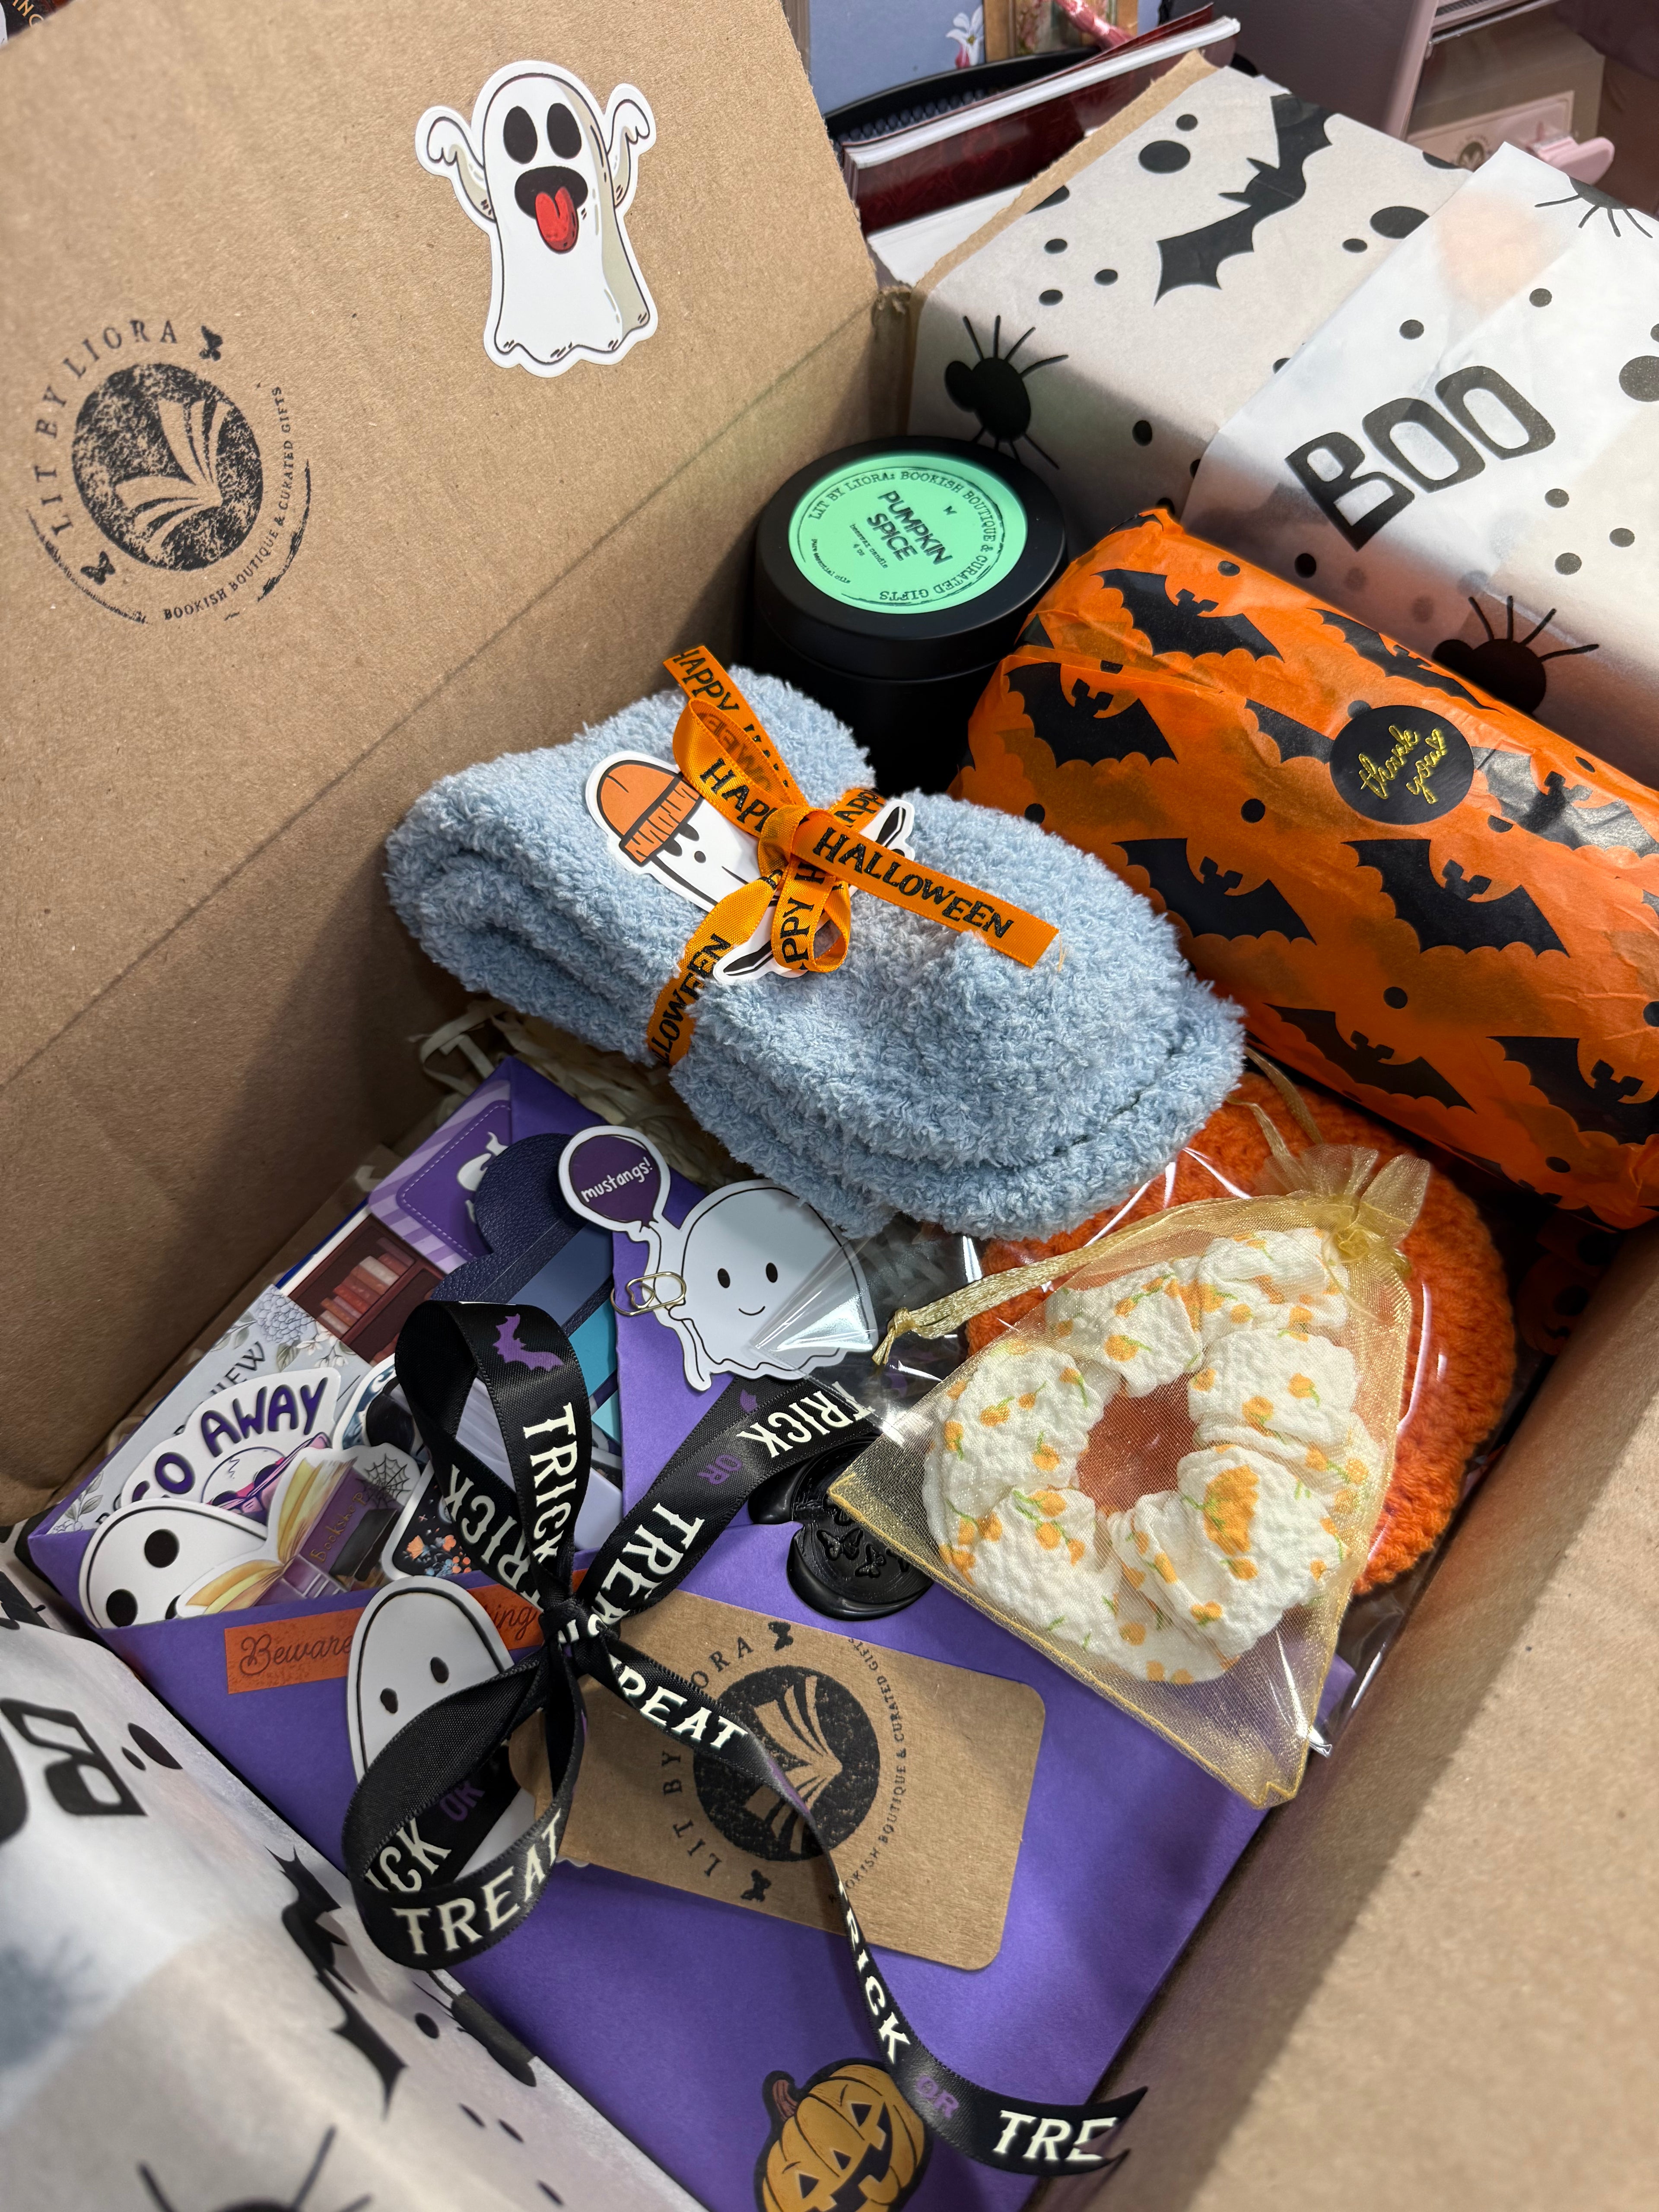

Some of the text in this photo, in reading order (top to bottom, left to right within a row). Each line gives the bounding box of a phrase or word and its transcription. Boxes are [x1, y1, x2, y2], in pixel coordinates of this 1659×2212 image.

[35, 320, 178, 536] LIT BY LIORA
[900, 471, 964, 493] BOOKISH
[1284, 365, 1556, 552] BOO
[164, 387, 294, 620] BOOKISH BOUTIQUE & CURATED GIFTS
[809, 502, 830, 520] LIT
[826, 489, 845, 501] BY
[963, 491, 996, 542] BOUTIQUE
[866, 513, 918, 561] SPICE
[877, 490, 953, 565] PUMPKIN
[869, 545, 888, 569] candle
[933, 555, 988, 594] CURATED
[879, 589, 929, 601] GIFTS
[1359, 724, 1421, 800] thank
[1406, 750, 1441, 804] you
[812, 827, 1014, 939] HALLOWEEN
[581, 1156, 653, 1203] mustangs!
[200, 1376, 329, 1457] AWAY
[736, 1381, 876, 1458] TRICK
[523, 1402, 578, 1564] TRICK
[699, 1454, 743, 1485] OR
[609, 1653, 748, 1749] REAT
[877, 1675, 904, 1742] CURATED
[661, 1751, 683, 1796] BY
[896, 1747, 906, 1758] &
[878, 1765, 906, 1843] BOUTIQUE
[673, 1819, 722, 1877] LIT
[391, 1808, 561, 1955] TREAT
[915, 2075, 959, 2119] OR
